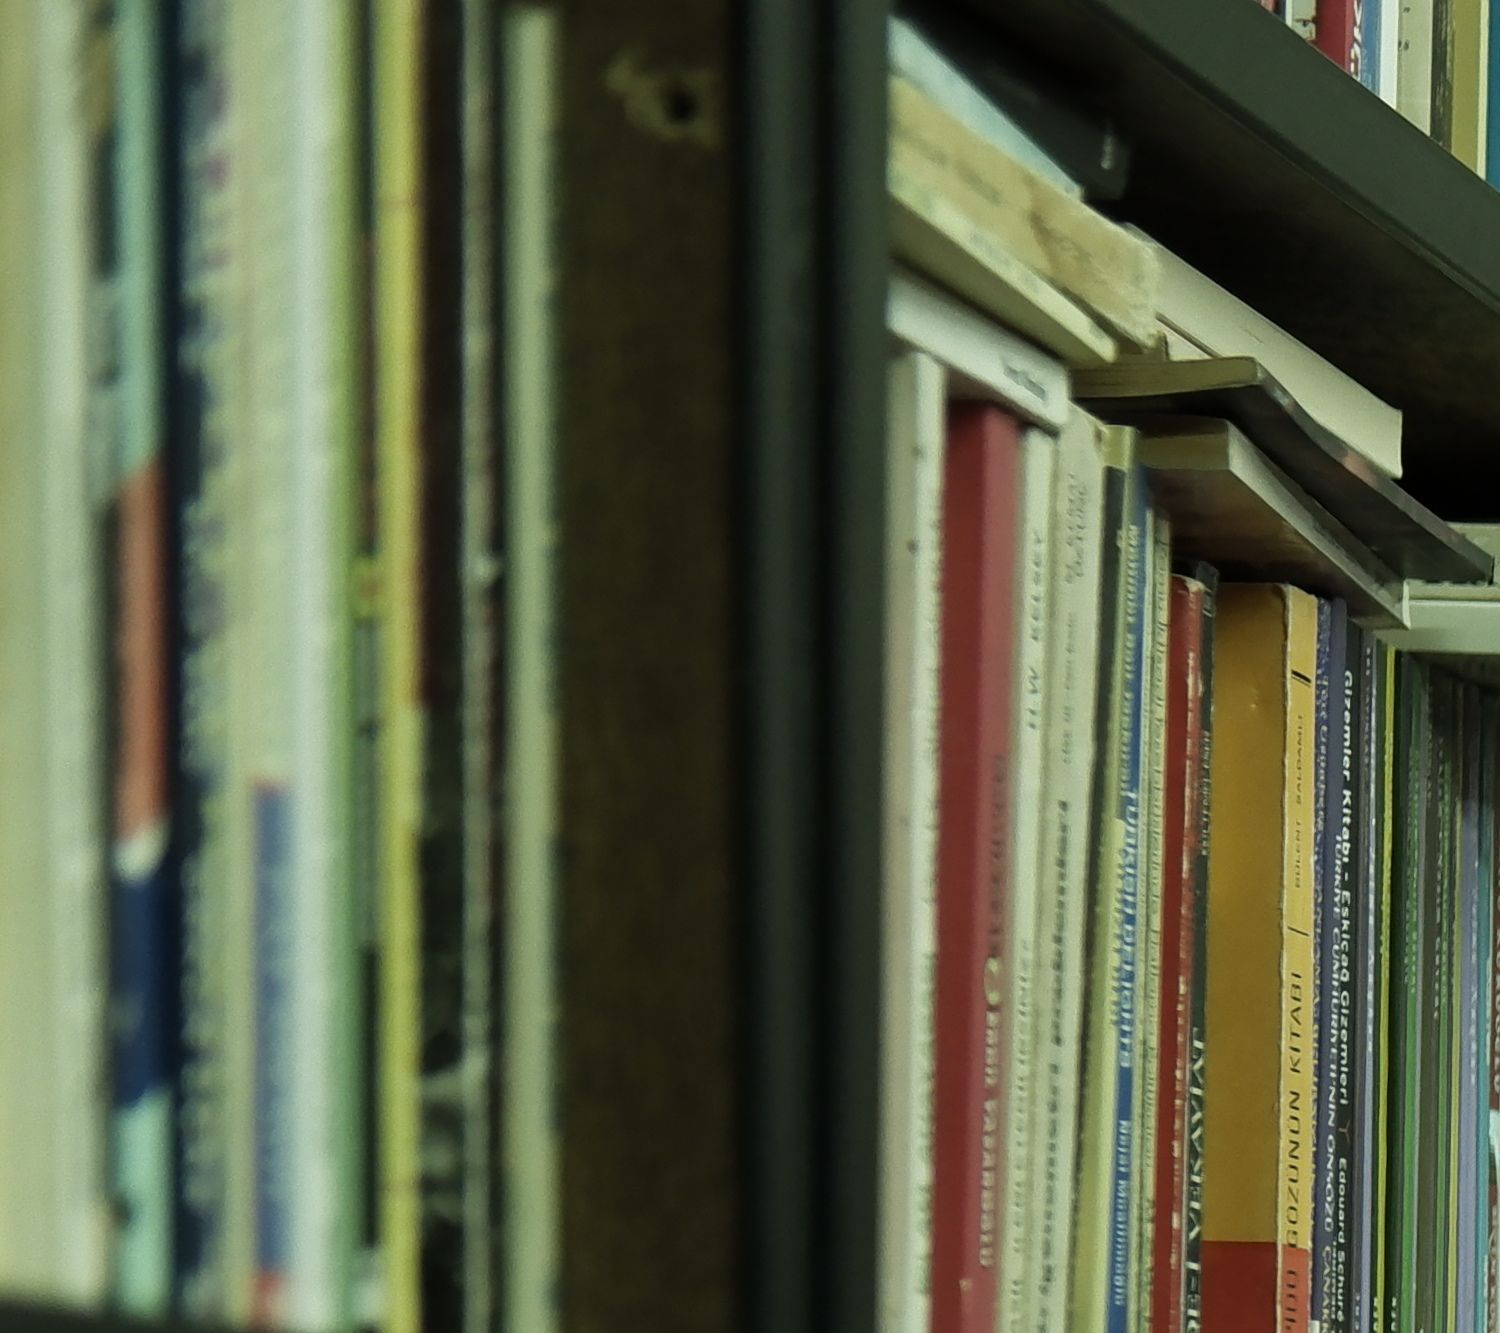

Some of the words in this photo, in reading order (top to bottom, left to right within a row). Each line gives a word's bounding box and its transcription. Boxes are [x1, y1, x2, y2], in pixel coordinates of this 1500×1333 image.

[1342, 670, 1353, 783] Gizemler
[1342, 788, 1353, 864] Kitabı
[1339, 990, 1350, 1106] Gizemleri
